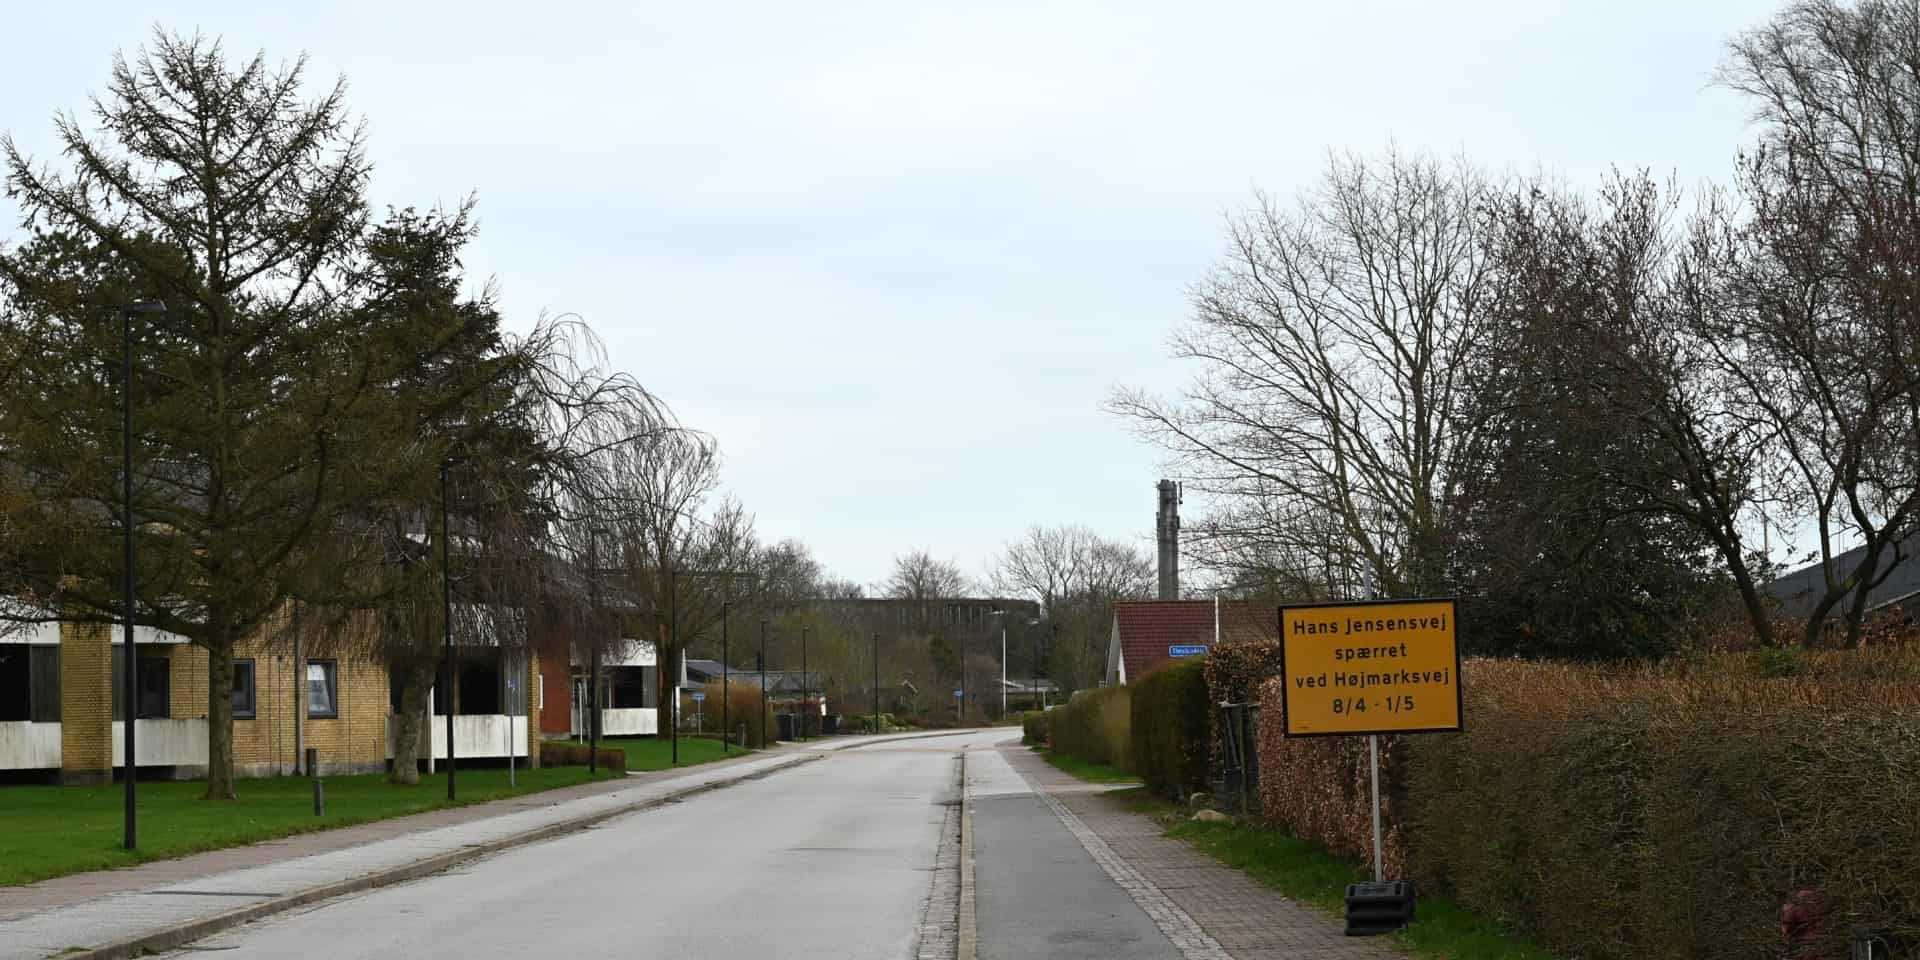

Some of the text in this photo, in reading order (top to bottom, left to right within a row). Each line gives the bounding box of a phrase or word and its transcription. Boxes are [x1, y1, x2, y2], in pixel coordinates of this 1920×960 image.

[1293, 614, 1446, 635] Hans Jensensvej
[1335, 643, 1407, 662] spærret
[1296, 667, 1449, 688] ved Højmarksvej
[1333, 697, 1366, 715] 8/4
[1386, 696, 1414, 713] 1/5
